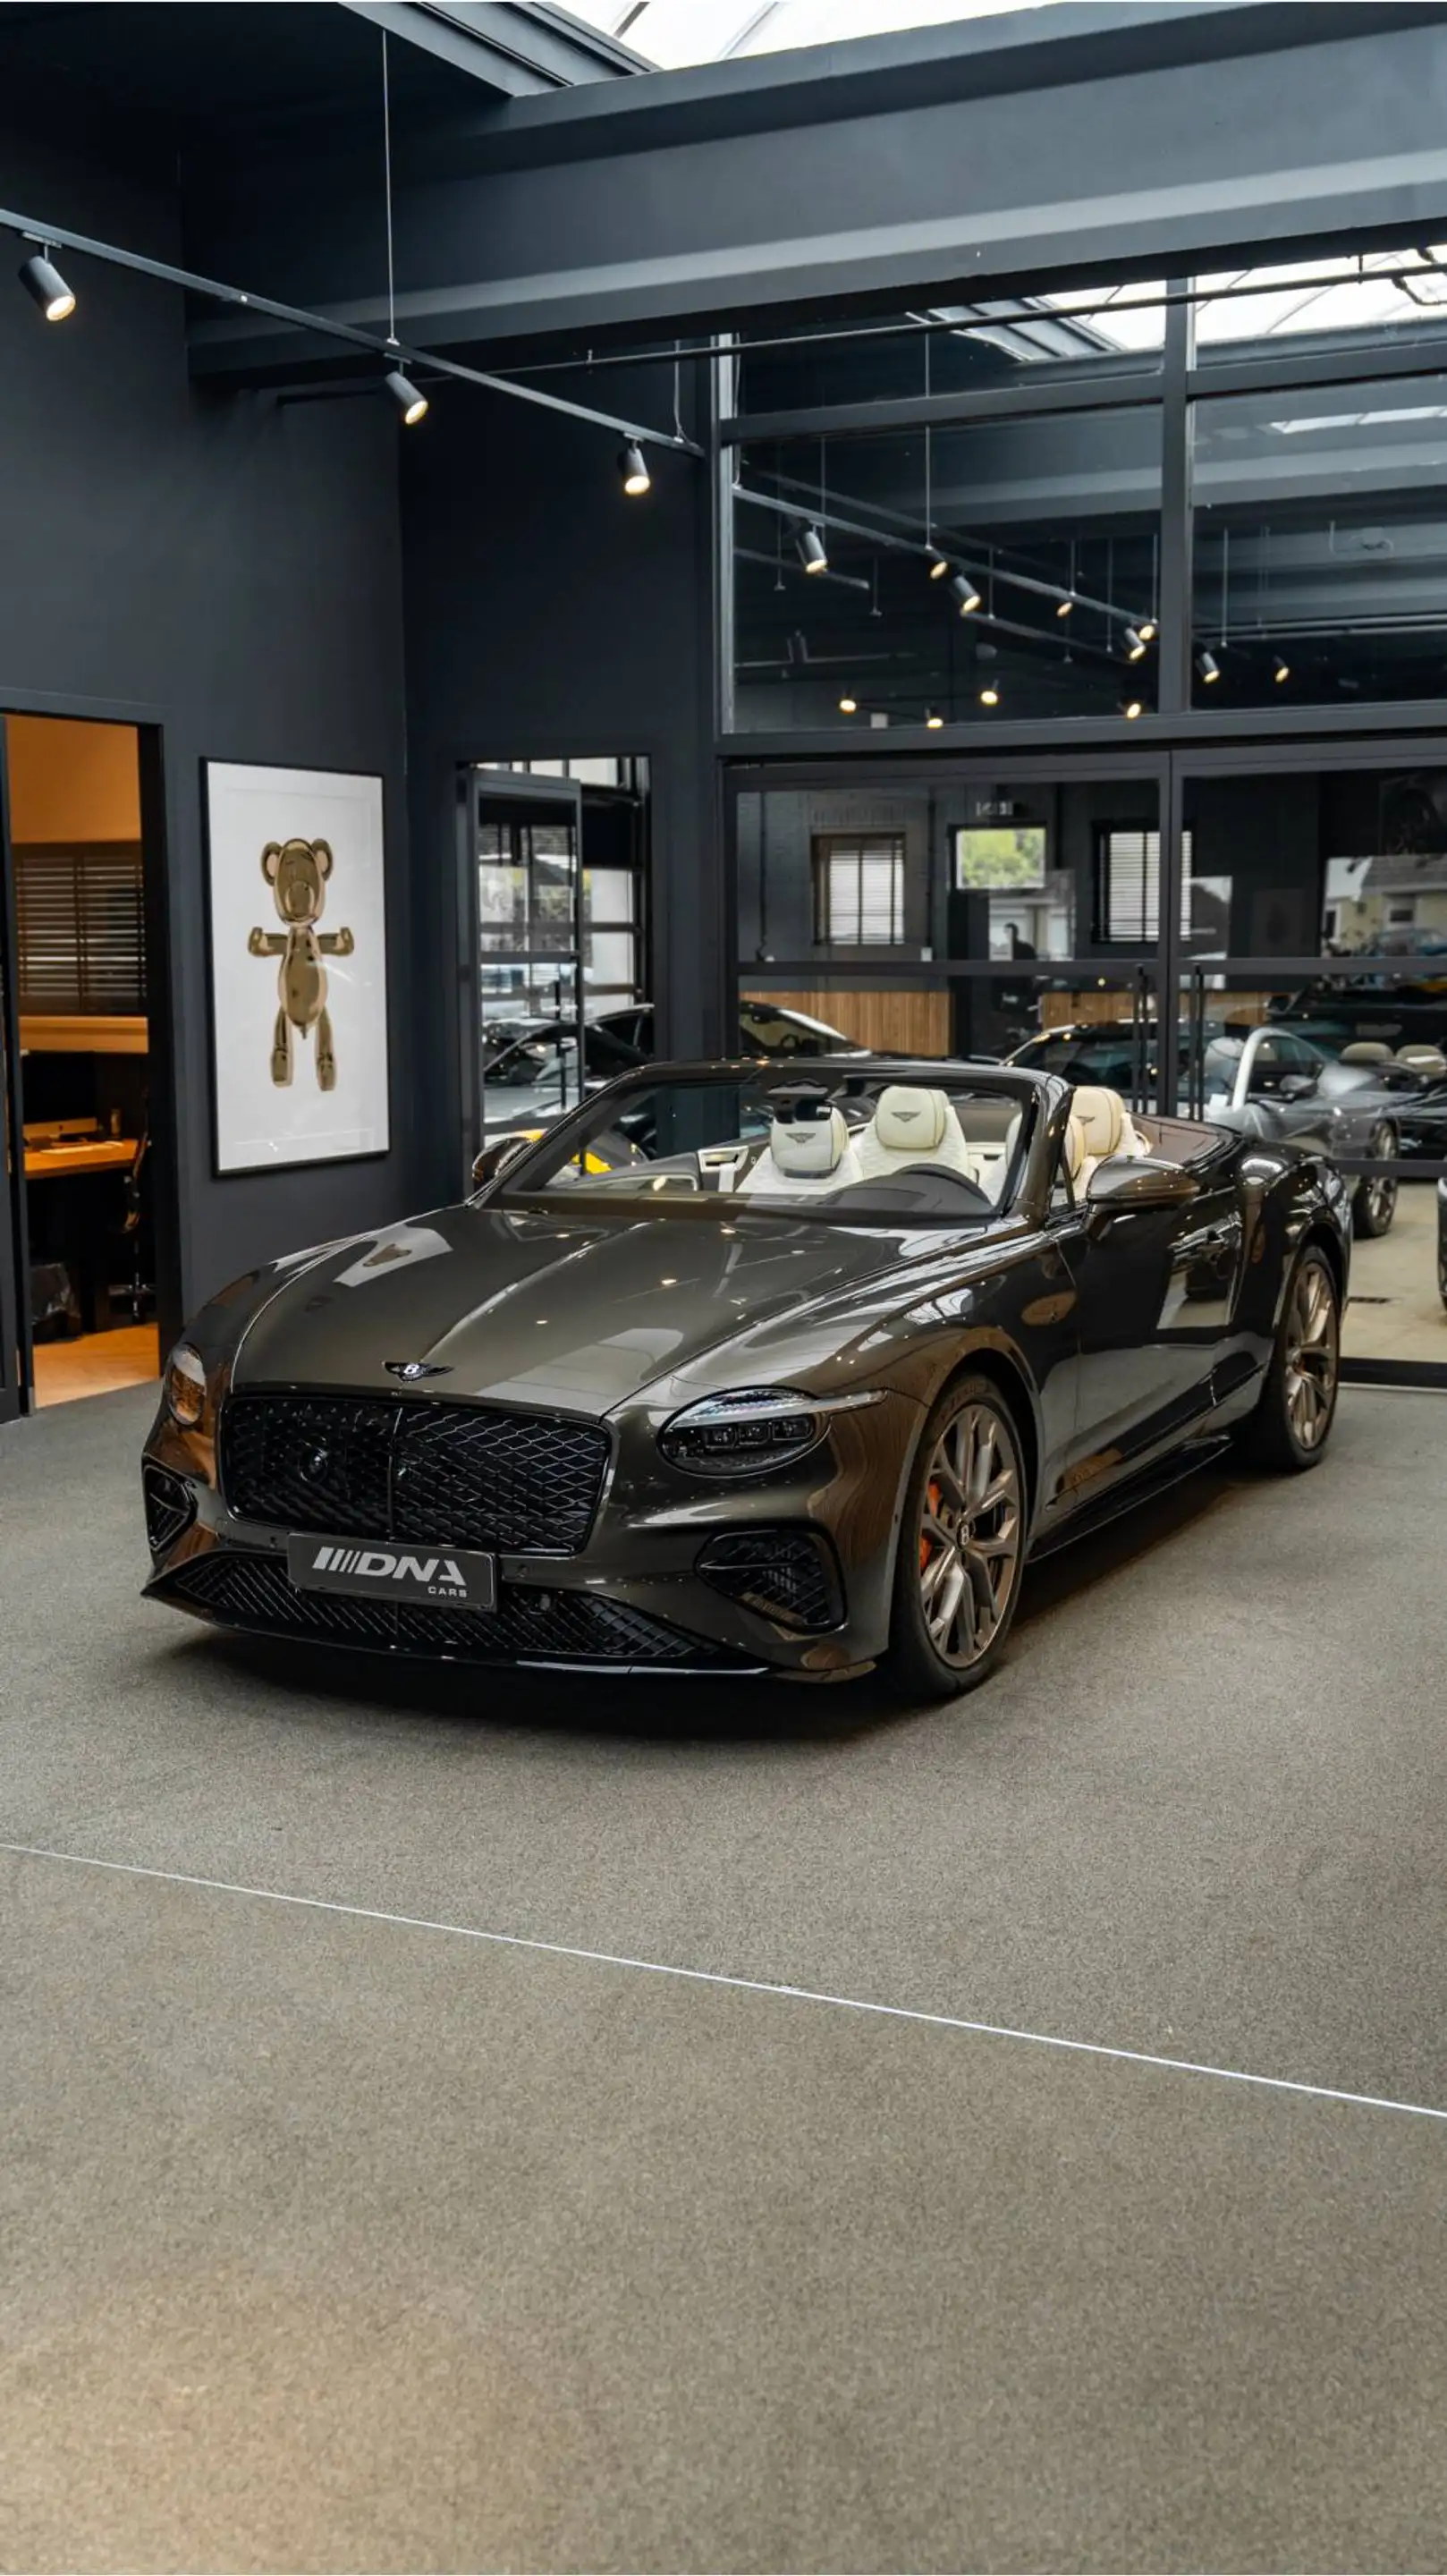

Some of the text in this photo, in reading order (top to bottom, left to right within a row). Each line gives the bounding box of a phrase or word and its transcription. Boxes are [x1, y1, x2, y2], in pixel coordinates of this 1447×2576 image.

[403, 1364, 419, 1375] B
[960, 1524, 969, 1546] B
[354, 1551, 467, 1586] DNA
[427, 1586, 468, 1597] CARS
